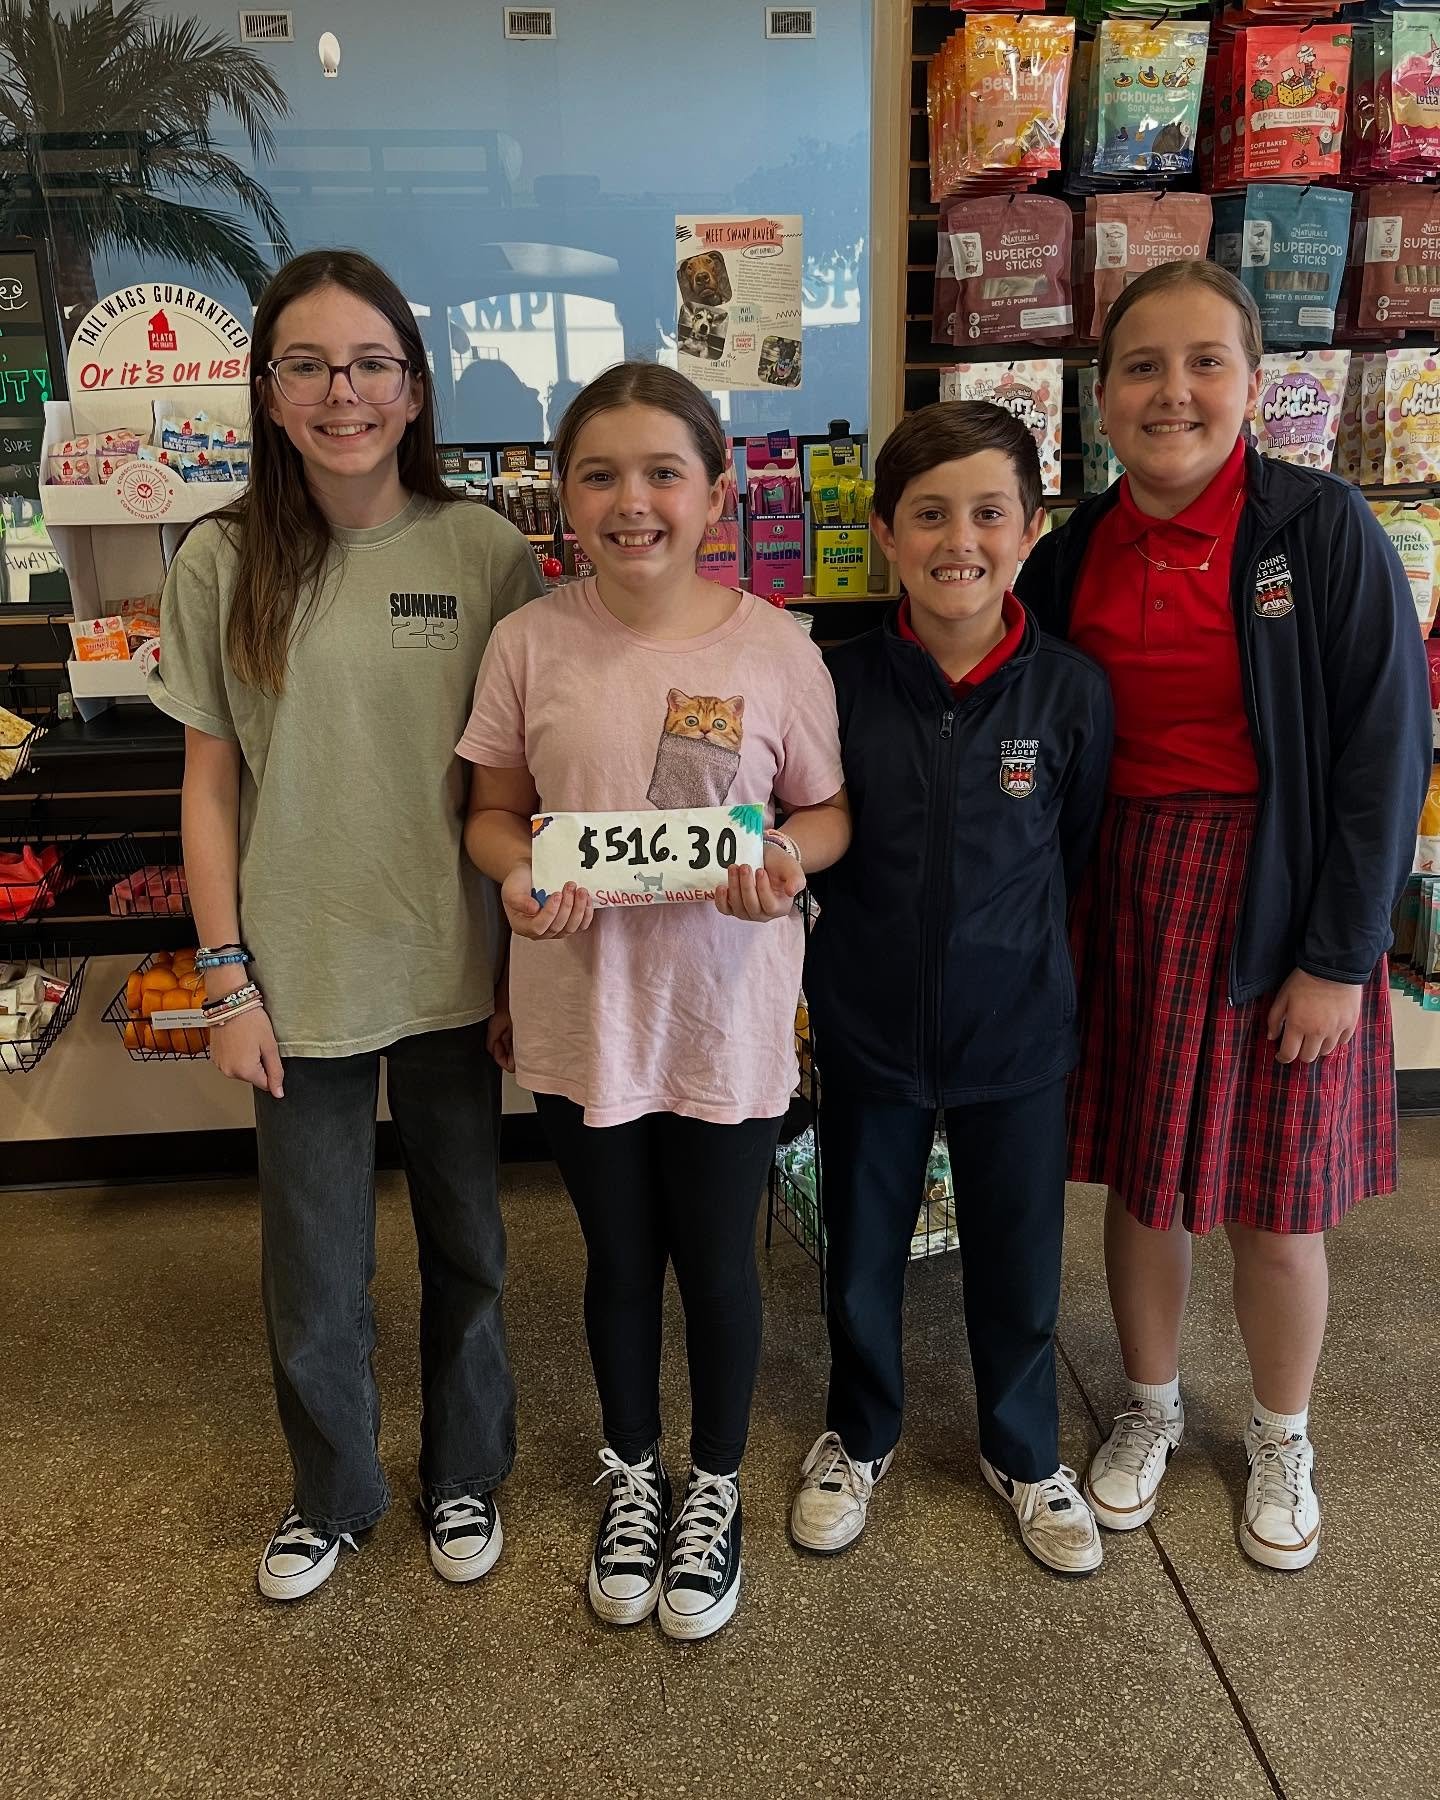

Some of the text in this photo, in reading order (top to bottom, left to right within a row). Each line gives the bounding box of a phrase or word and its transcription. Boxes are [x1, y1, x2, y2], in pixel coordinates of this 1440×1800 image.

[1257, 110, 1338, 121] APPLE CIDER DONUT
[1250, 139, 1288, 150] SOFT BAKED
[705, 226, 775, 242] MEET SWAMP HAVEN
[1143, 231, 1183, 242] NATURALS
[1290, 227, 1328, 239] NATURALS
[1001, 233, 1040, 246] NATURALS
[985, 245, 1058, 261] SUPERFOOD
[1129, 244, 1200, 256] SUPERFOOD
[1273, 242, 1342, 256] SUPERFOOD
[1005, 259, 1043, 271] STICKS
[1292, 255, 1327, 266] STICKS
[991, 299, 1004, 307] BEEF
[1014, 297, 1038, 305] PUMPKIN
[78, 285, 250, 349] TAIL WAGS GUARANTEED
[151, 333, 175, 342] PLATO
[80, 352, 250, 389] Or it's on us!
[1275, 384, 1319, 404] MUTT
[1267, 434, 1290, 448] Maple
[117, 463, 169, 485] CONSCIOUSLY MADE
[120, 499, 173, 520] CONSCIOUSLY MADE
[755, 541, 801, 553] FLAVOR
[823, 547, 864, 557] FLAVOR
[755, 549, 801, 561] FUSION
[822, 554, 864, 565] FUSION
[389, 592, 458, 620] SUMMER
[391, 618, 459, 650] 23
[1000, 741, 1013, 749] ST.
[596, 889, 715, 906] SWAMP HAVEN
[1289, 1433, 1303, 1441] NIKE
